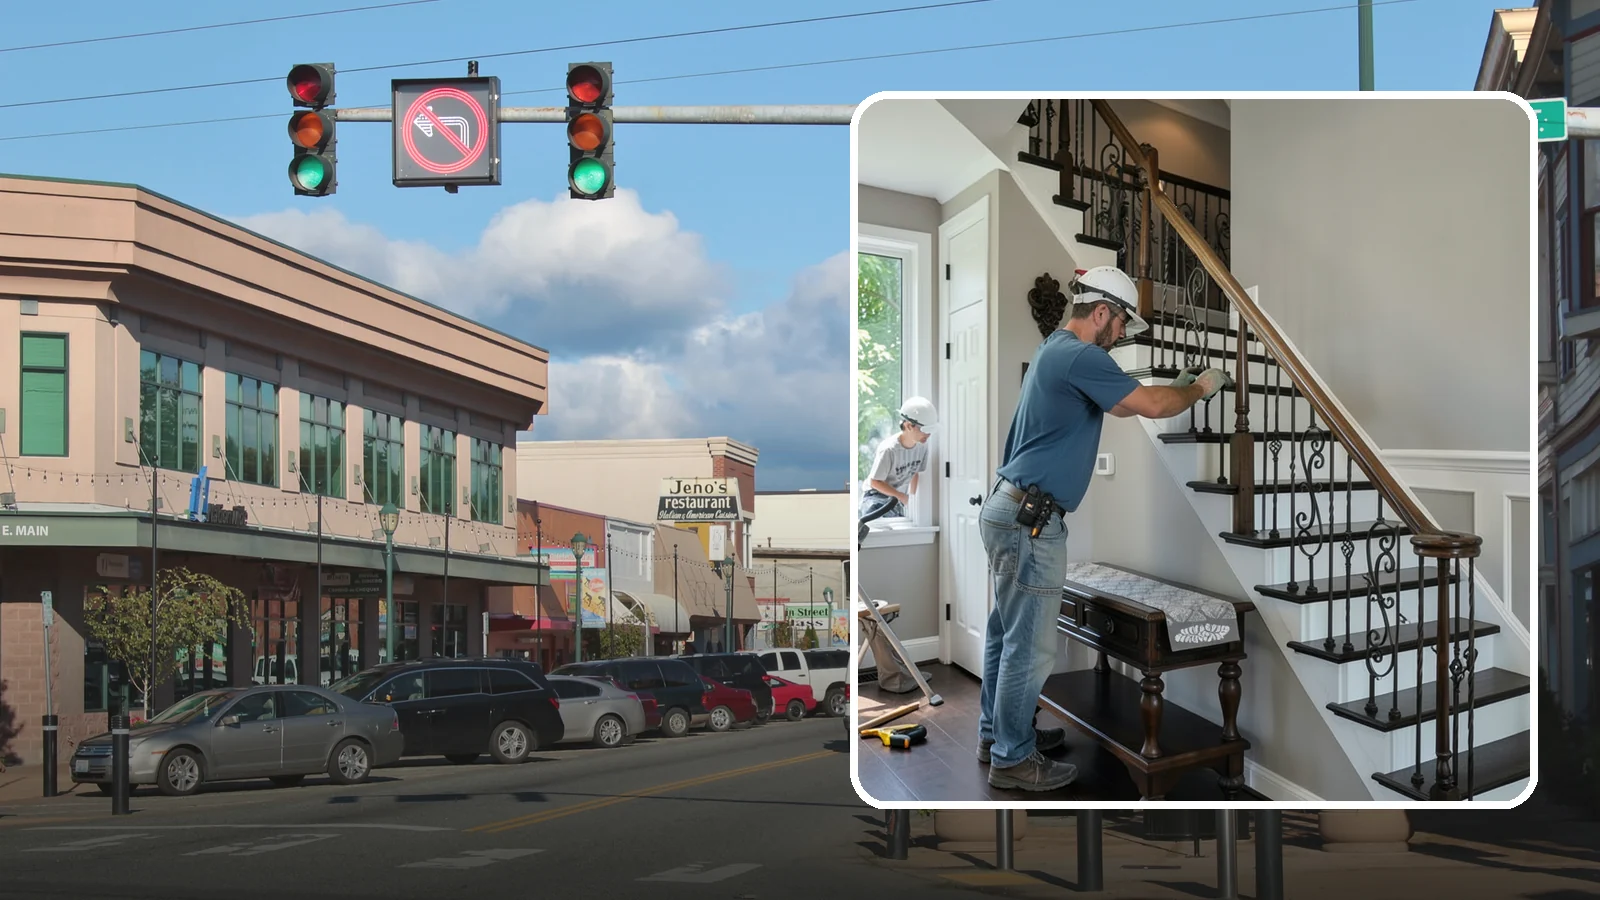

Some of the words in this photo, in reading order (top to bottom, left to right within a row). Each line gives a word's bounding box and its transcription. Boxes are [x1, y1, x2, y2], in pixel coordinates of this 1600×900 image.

[669, 480, 728, 495] Jeno's
[665, 496, 731, 509] restaurant
[658, 510, 682, 520] Italian
[685, 509, 715, 519] American
[715, 509, 738, 519] Cuisine
[2, 525, 13, 536] E.
[16, 525, 49, 536] MAIN
[797, 607, 829, 617] Street
